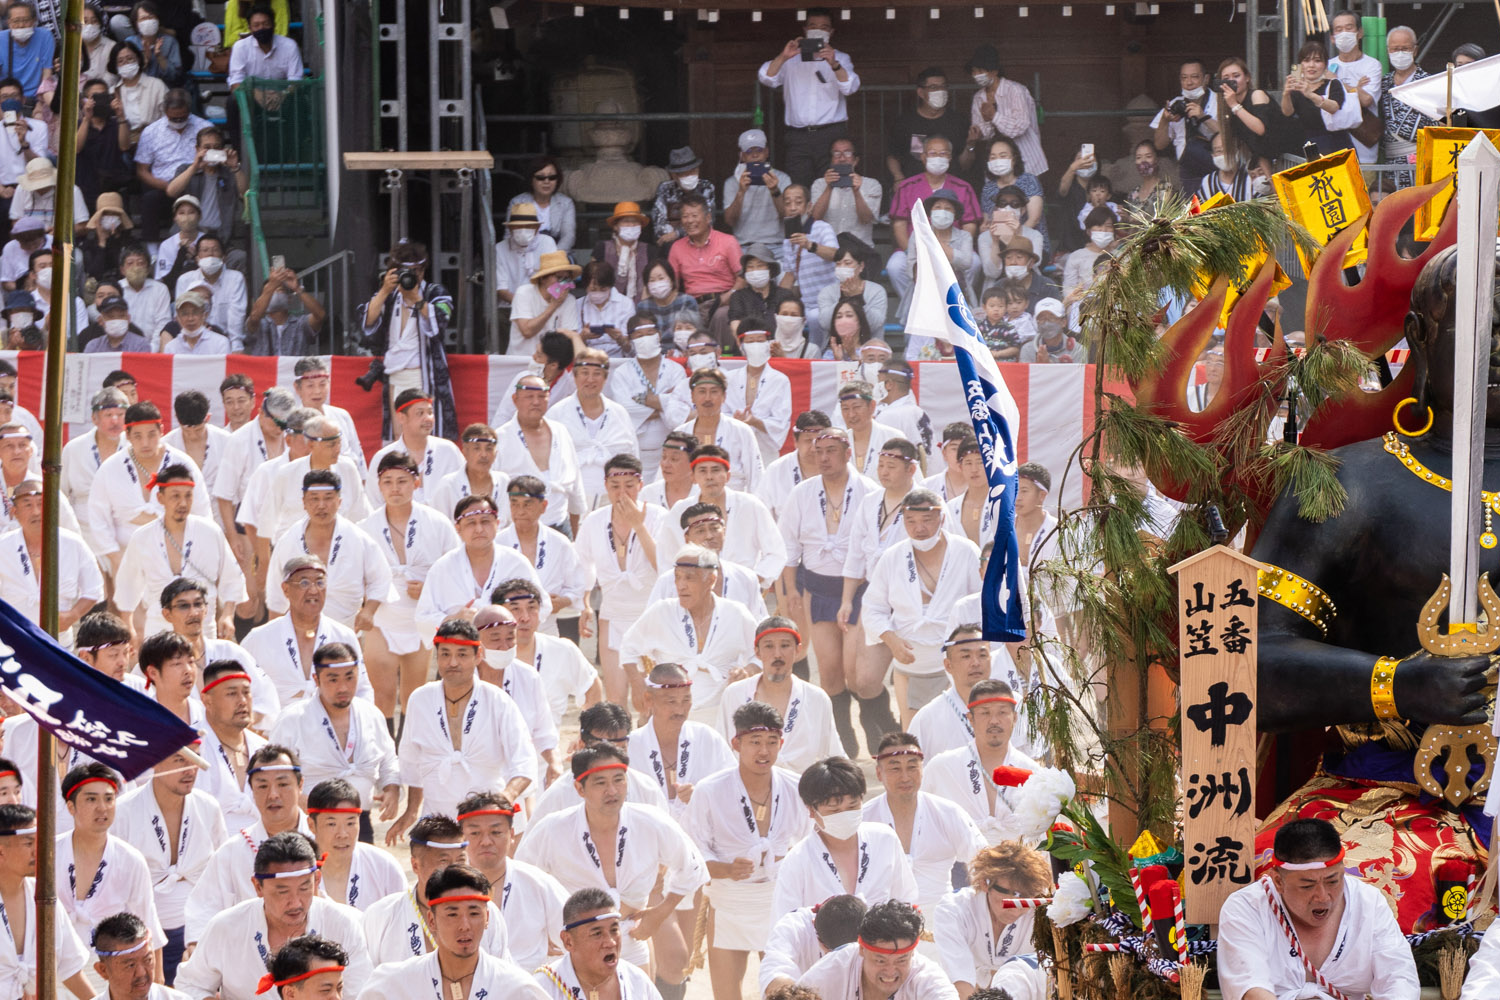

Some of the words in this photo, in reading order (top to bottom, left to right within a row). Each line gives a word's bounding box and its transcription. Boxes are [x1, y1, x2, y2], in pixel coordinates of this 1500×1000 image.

[1308, 169, 1347, 242] 祇園
[1183, 581, 1219, 659] 山笠
[1219, 578, 1256, 655] 五番
[1186, 680, 1254, 886] 中洲流
